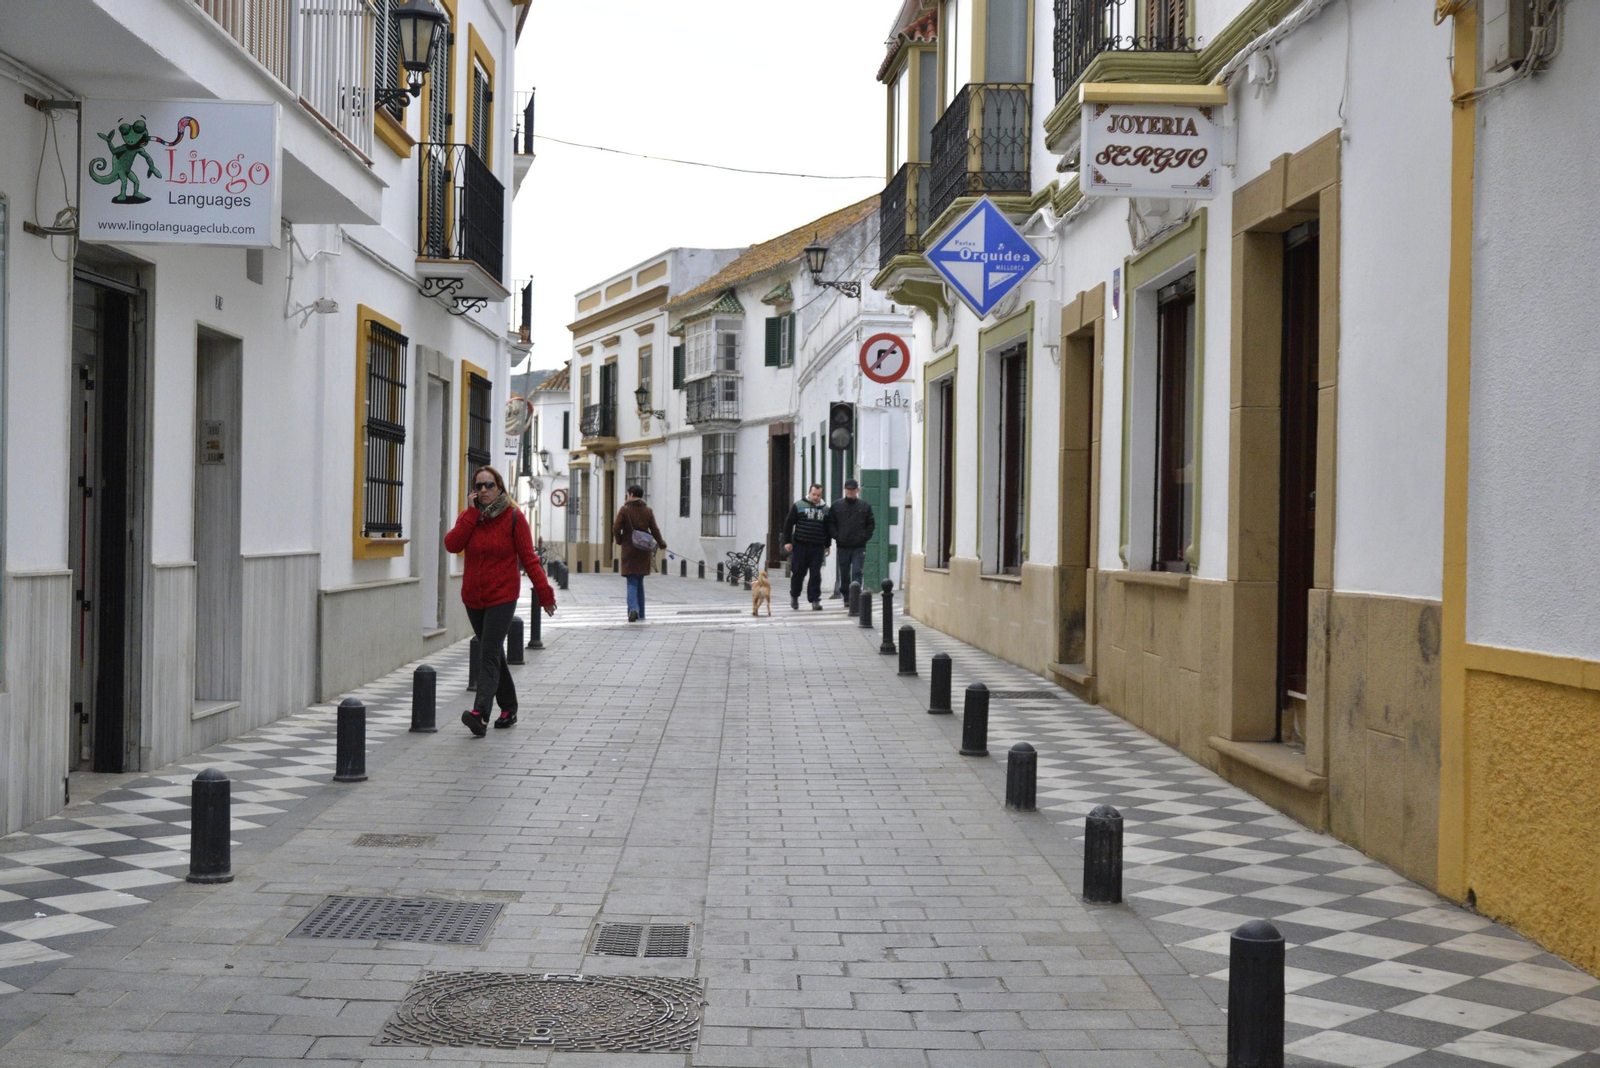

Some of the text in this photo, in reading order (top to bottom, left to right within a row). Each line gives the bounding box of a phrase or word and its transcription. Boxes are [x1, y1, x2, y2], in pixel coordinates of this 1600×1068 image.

[1106, 114, 1199, 136] JOYERIA
[1095, 144, 1208, 174] SERGIO
[165, 149, 270, 194] Lingo
[168, 191, 251, 209] Languages
[98, 220, 256, 235] www.lingolanguageclub.com
[876, 397, 909, 407] CRUZ
[885, 390, 900, 398] LA
